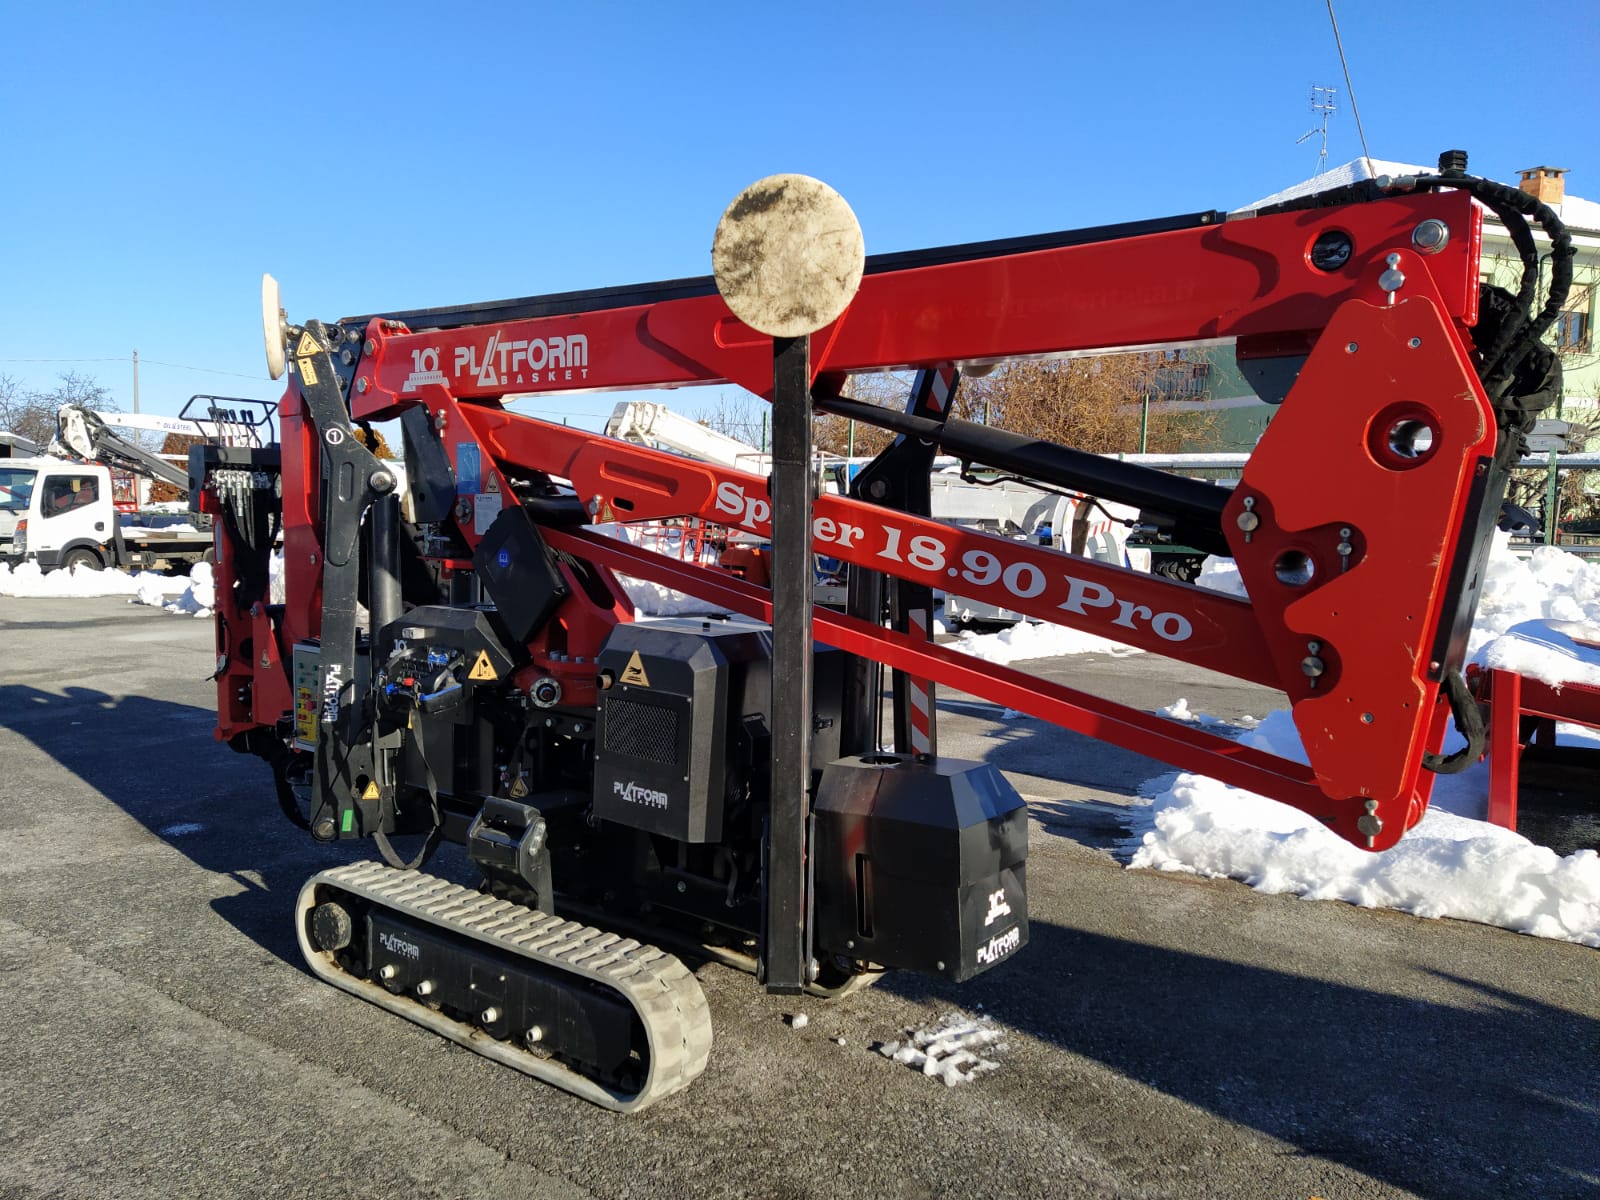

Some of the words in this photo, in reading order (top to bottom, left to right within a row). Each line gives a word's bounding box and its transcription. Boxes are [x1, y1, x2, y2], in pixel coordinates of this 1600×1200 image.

[455, 330, 588, 386] PLATFORM
[501, 368, 589, 385] BASKET
[715, 481, 864, 549] Sper
[875, 524, 1047, 599] 18.90
[1058, 574, 1193, 642] Pro
[325, 664, 343, 722] PLATFORM
[614, 781, 667, 806] PLATFORM
[380, 932, 419, 958] PLATFORM
